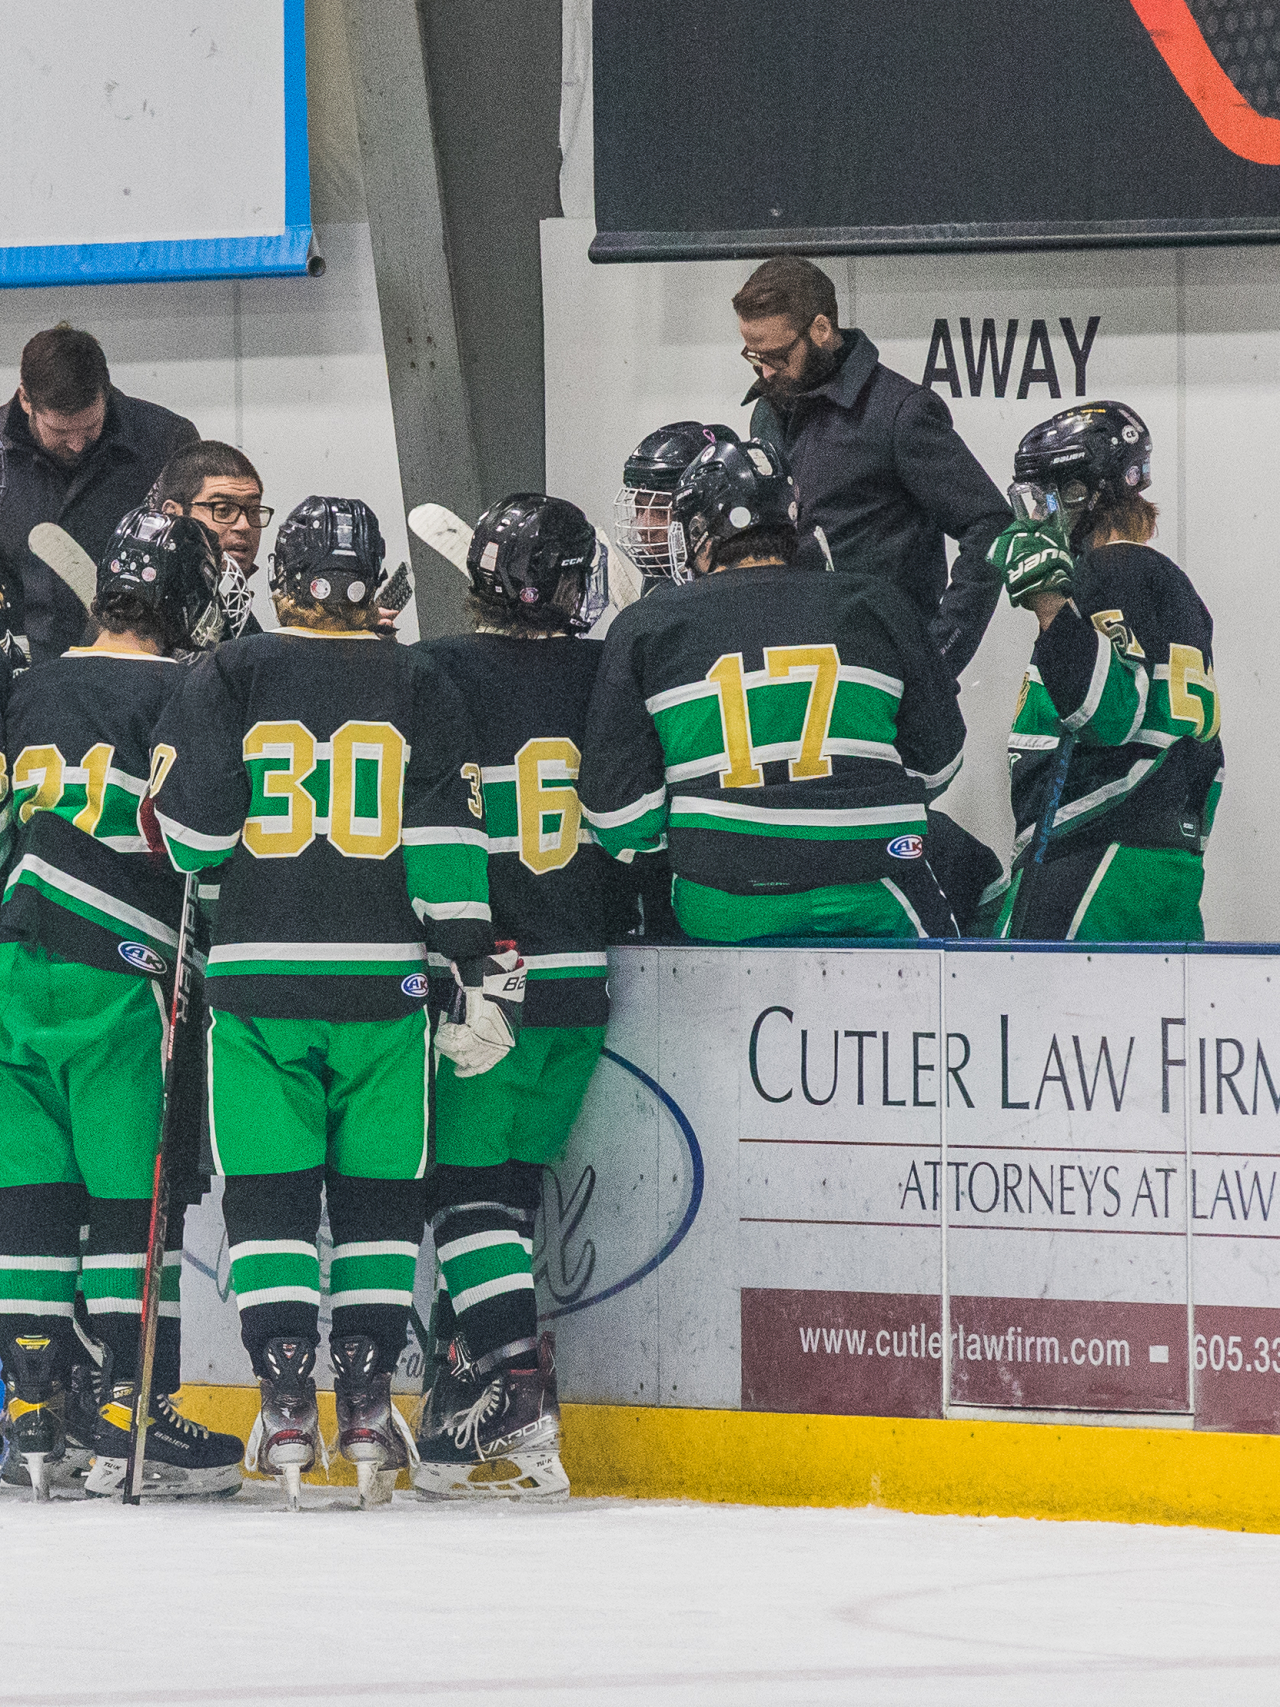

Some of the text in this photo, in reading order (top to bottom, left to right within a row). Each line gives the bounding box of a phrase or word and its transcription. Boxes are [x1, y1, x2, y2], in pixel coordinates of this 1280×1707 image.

[922, 316, 1101, 400] AWAY
[706, 642, 841, 790] 17
[12, 741, 116, 838] 21
[241, 719, 408, 860] 30
[459, 762, 483, 820] 3
[513, 736, 583, 877] 6
[748, 1005, 975, 1110] CUTLER
[1000, 1013, 1135, 1113] LAW
[900, 1159, 1278, 1222] ATTORNEYS AT LAW
[799, 1323, 1131, 1367] www.cutlerlawfirm.com
